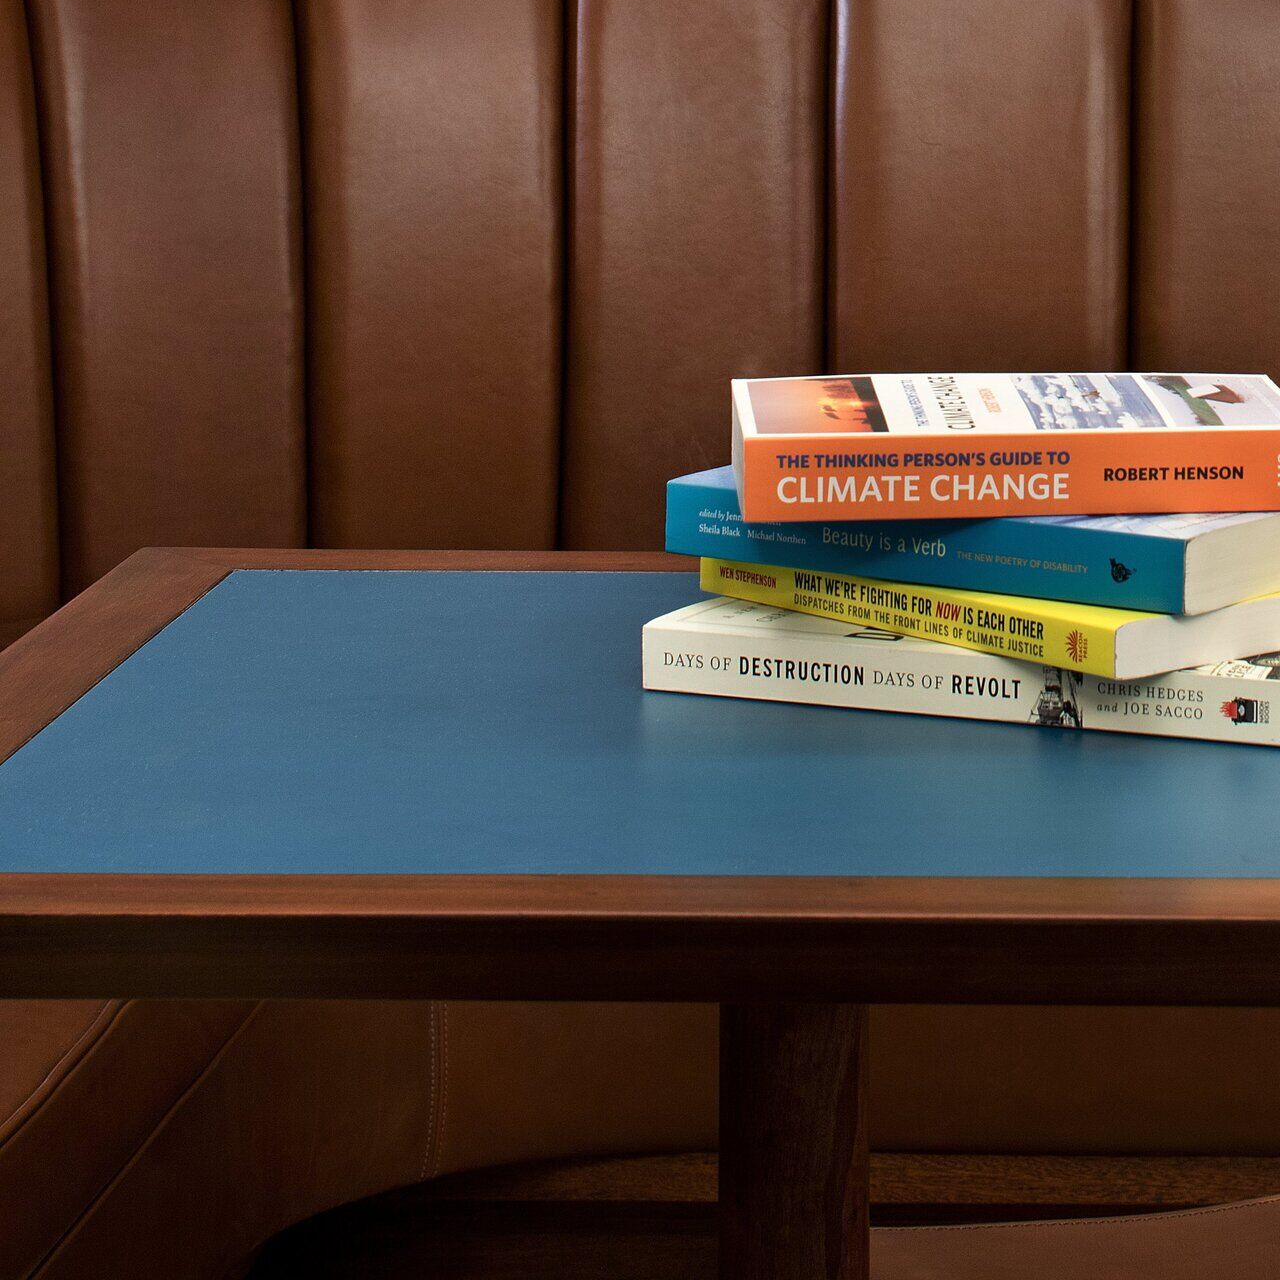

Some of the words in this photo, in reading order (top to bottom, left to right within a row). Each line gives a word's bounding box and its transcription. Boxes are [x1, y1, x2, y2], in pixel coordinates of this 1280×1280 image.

[777, 454, 809, 469] THE
[814, 453, 898, 468] THINKING
[990, 452, 1042, 466] GUIDE
[1047, 451, 1070, 465] TO
[1104, 467, 1169, 482] ROBERT
[1174, 466, 1244, 481] HENSON
[777, 475, 920, 503] CLIMATE
[930, 473, 1070, 501] CHANGE
[822, 527, 873, 552] Beauty
[879, 532, 891, 550] is
[897, 539, 906, 553] a
[911, 537, 946, 558] Verb
[957, 550, 972, 560] THE
[974, 552, 993, 563] NEW
[995, 555, 1028, 567] POETRY
[1030, 558, 1041, 568] OF
[1043, 560, 1088, 574] DISABILITY
[719, 565, 734, 579] WEN
[735, 568, 777, 589] STEPHENSON
[794, 571, 822, 593] WHAT
[861, 584, 908, 611] FIGHTING
[911, 595, 932, 617] FOR
[935, 601, 962, 623] NOW
[963, 605, 973, 625] IS
[977, 609, 1005, 631] EACH
[1009, 615, 1044, 640] OTHER
[794, 592, 845, 615] DISPATCHES
[848, 603, 871, 621] FROM
[874, 609, 891, 625] THE
[894, 614, 920, 631] FRONT
[924, 621, 949, 638] LINES
[953, 627, 963, 640] OF
[966, 630, 1004, 649] CLIMATE
[1008, 638, 1044, 657] JUSTICE
[663, 652, 704, 669] DAYS
[710, 657, 732, 671] OF
[739, 656, 864, 686] DESTRUCTION
[873, 670, 915, 689] DAYS
[921, 675, 943, 690] OF
[952, 674, 1021, 699] REVOLT
[1097, 682, 1141, 697] CHRIS
[1146, 685, 1204, 702] HEDGES
[1097, 702, 1118, 713] and
[1124, 702, 1149, 717] JOE
[1156, 703, 1204, 720] SACCO
